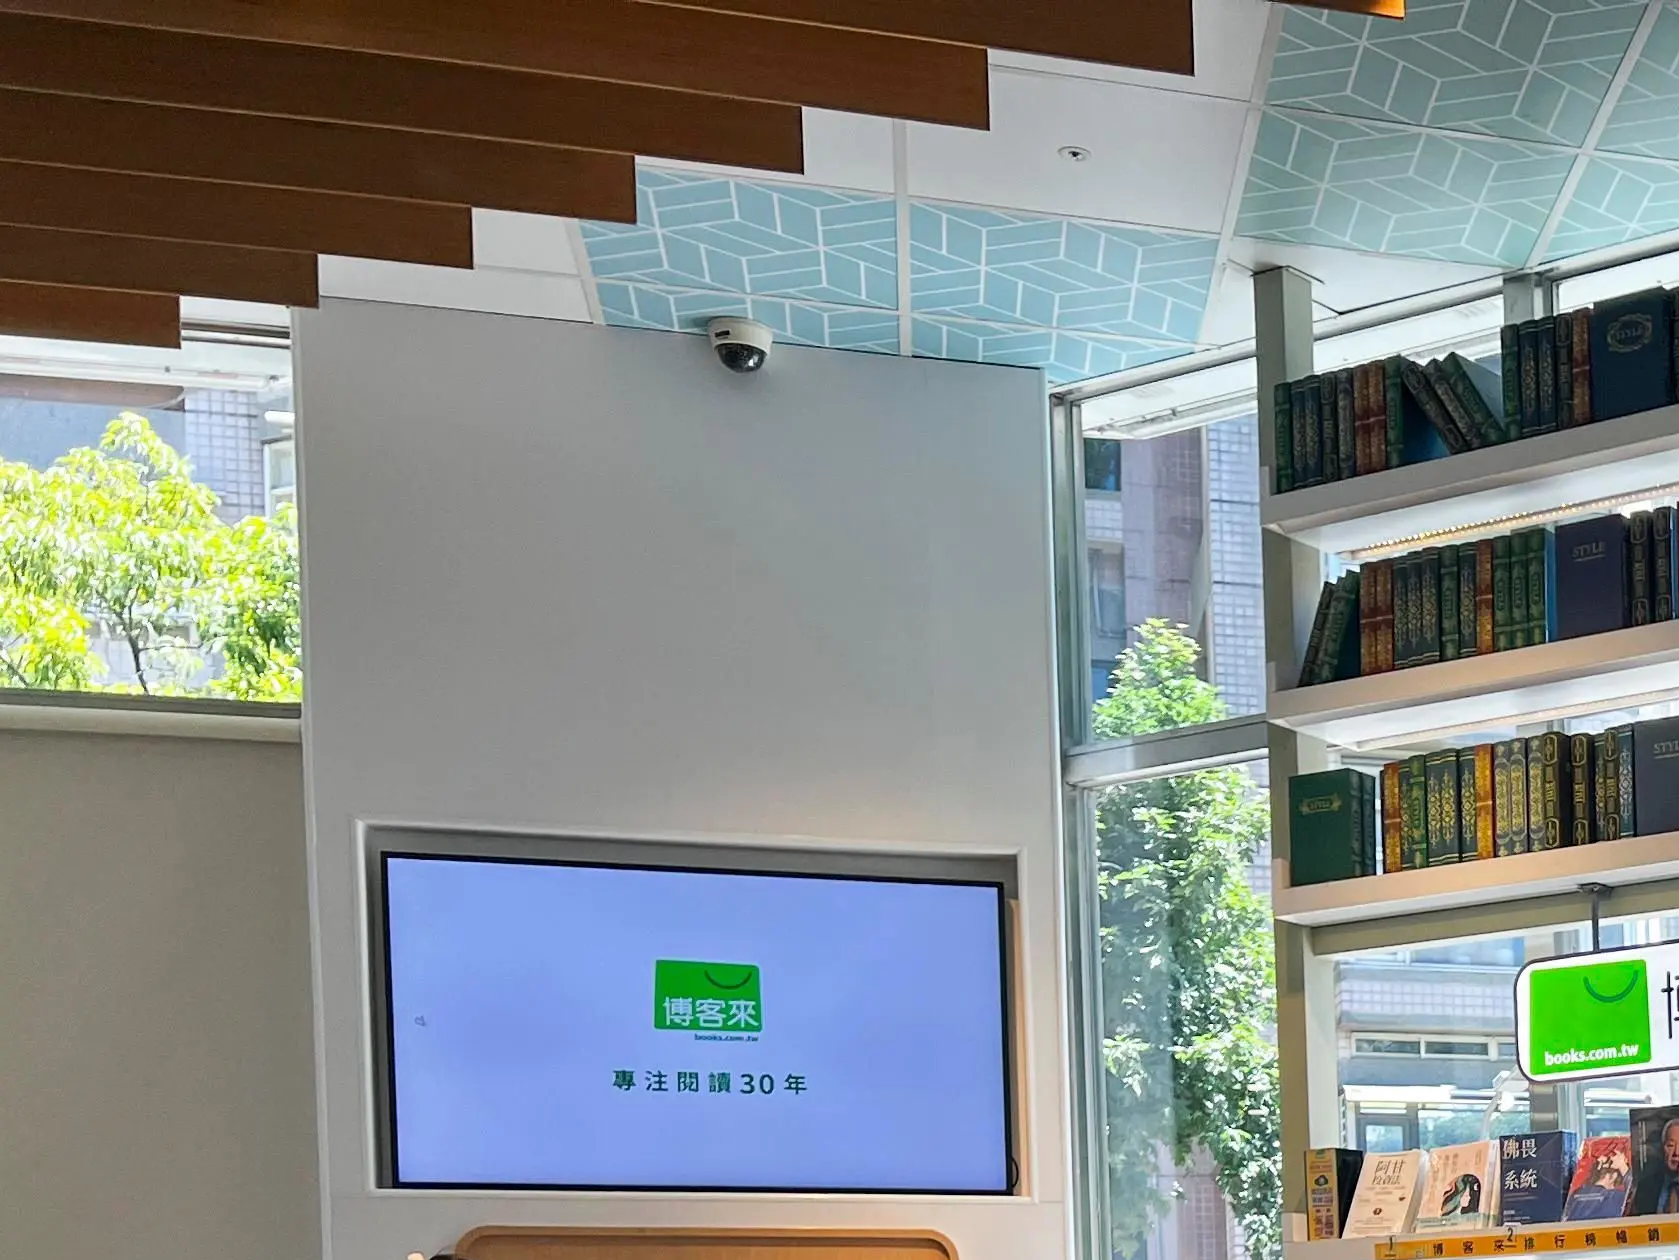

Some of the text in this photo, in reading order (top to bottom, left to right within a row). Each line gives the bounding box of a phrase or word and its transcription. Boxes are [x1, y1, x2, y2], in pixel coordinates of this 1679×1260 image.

[662, 996, 760, 1029] 博客來
[1544, 1043, 1639, 1067] books.com.tw
[611, 1068, 808, 1096] 專注閱讀30年
[1504, 1168, 1538, 1190] 系統
